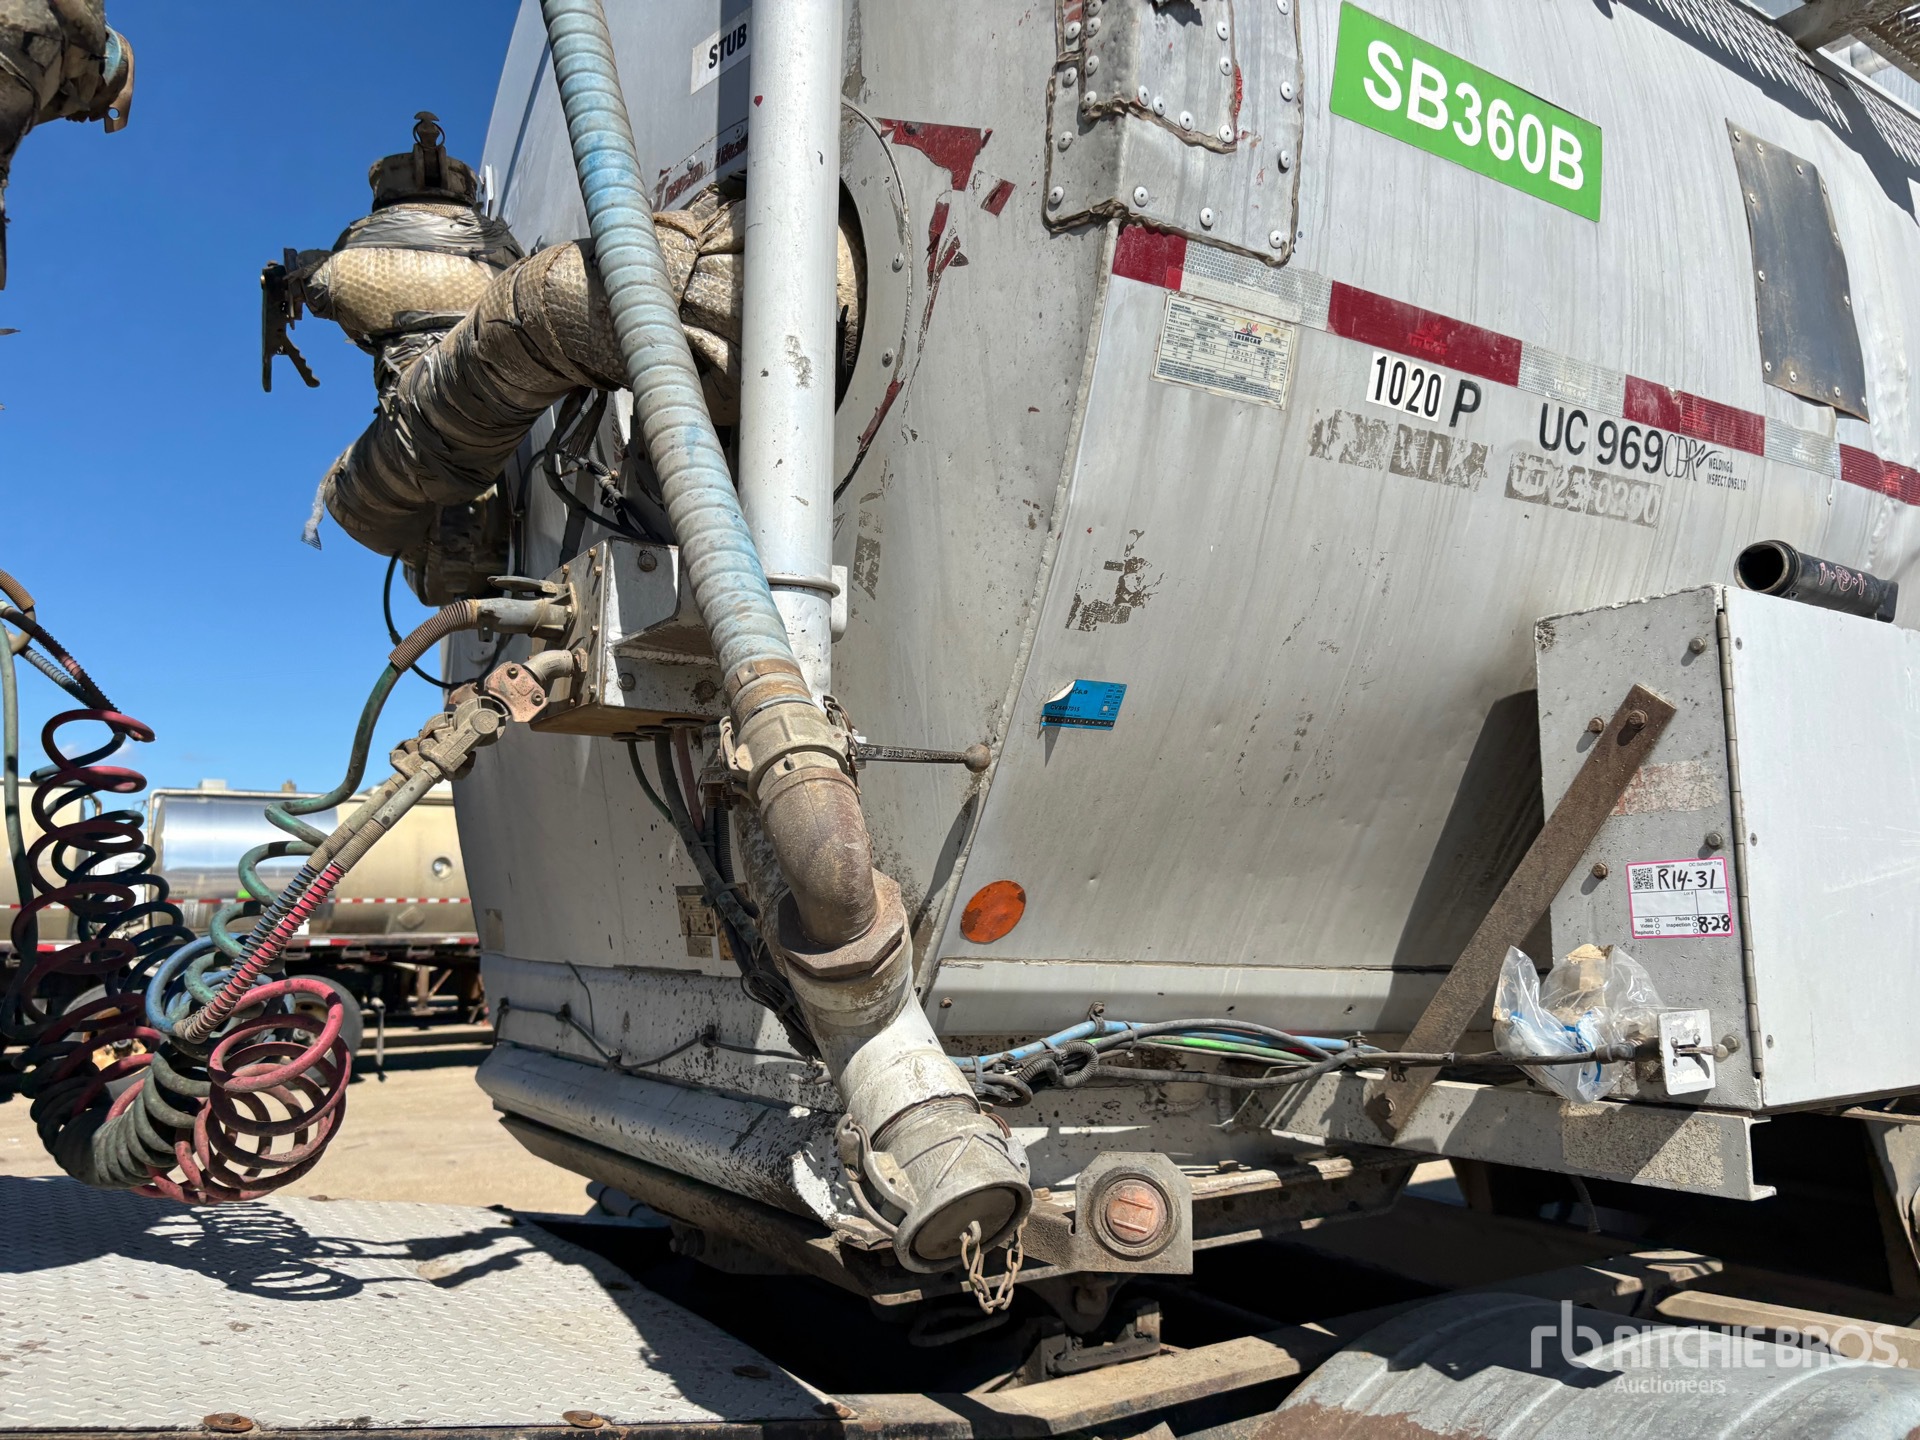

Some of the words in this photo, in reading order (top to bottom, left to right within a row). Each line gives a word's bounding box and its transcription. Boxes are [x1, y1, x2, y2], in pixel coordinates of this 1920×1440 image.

[708, 23, 747, 69] STUB
[1363, 40, 1584, 191] SB360B
[1374, 355, 1442, 417] 1020
[1448, 379, 1482, 428] P
[1539, 403, 1589, 455] UC
[1597, 420, 1664, 474] 969
[1658, 868, 1715, 890] R14-31
[1698, 914, 1731, 933] 8-28
